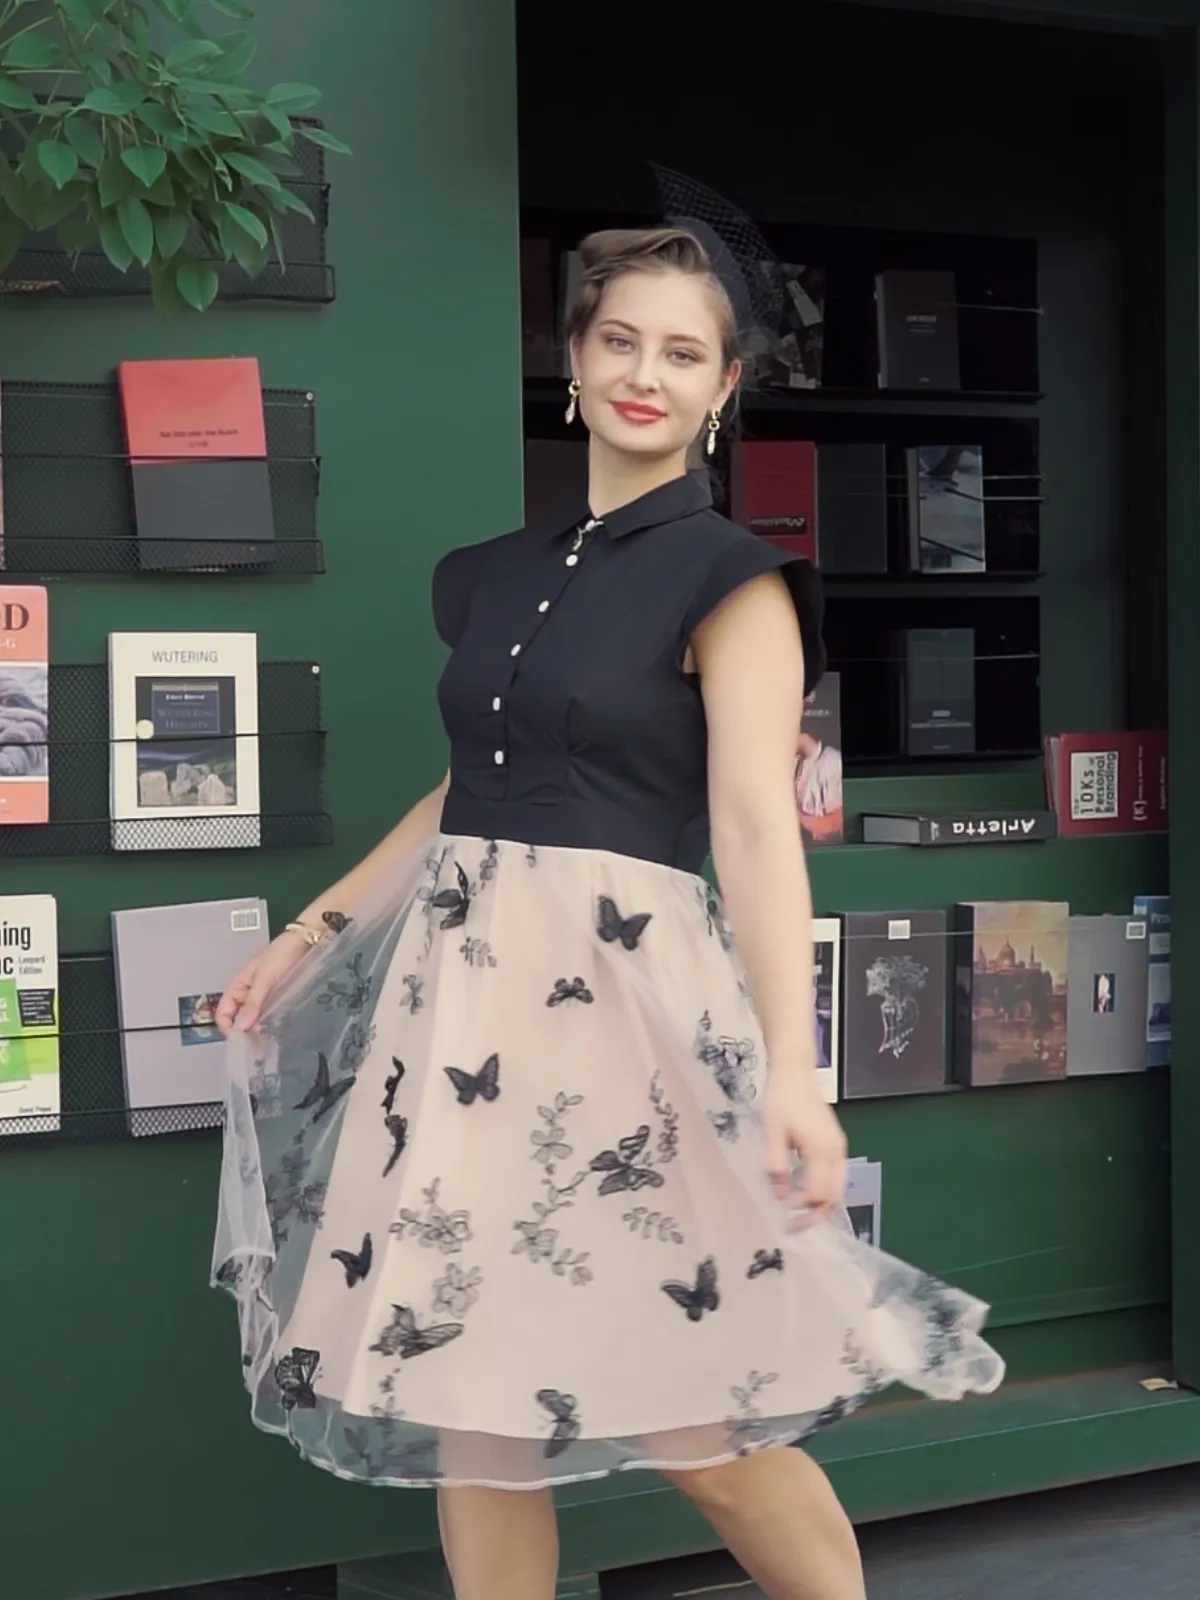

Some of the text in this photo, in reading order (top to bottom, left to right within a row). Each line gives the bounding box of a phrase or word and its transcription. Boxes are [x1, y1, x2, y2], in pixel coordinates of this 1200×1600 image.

[0, 603, 30, 631] D
[151, 650, 219, 663] WUTERING
[1095, 755, 1105, 813] Personal
[1104, 752, 1117, 813] Branding
[952, 818, 1036, 836] Arletta
[0, 920, 31, 951] ing
[0, 956, 14, 975] c
